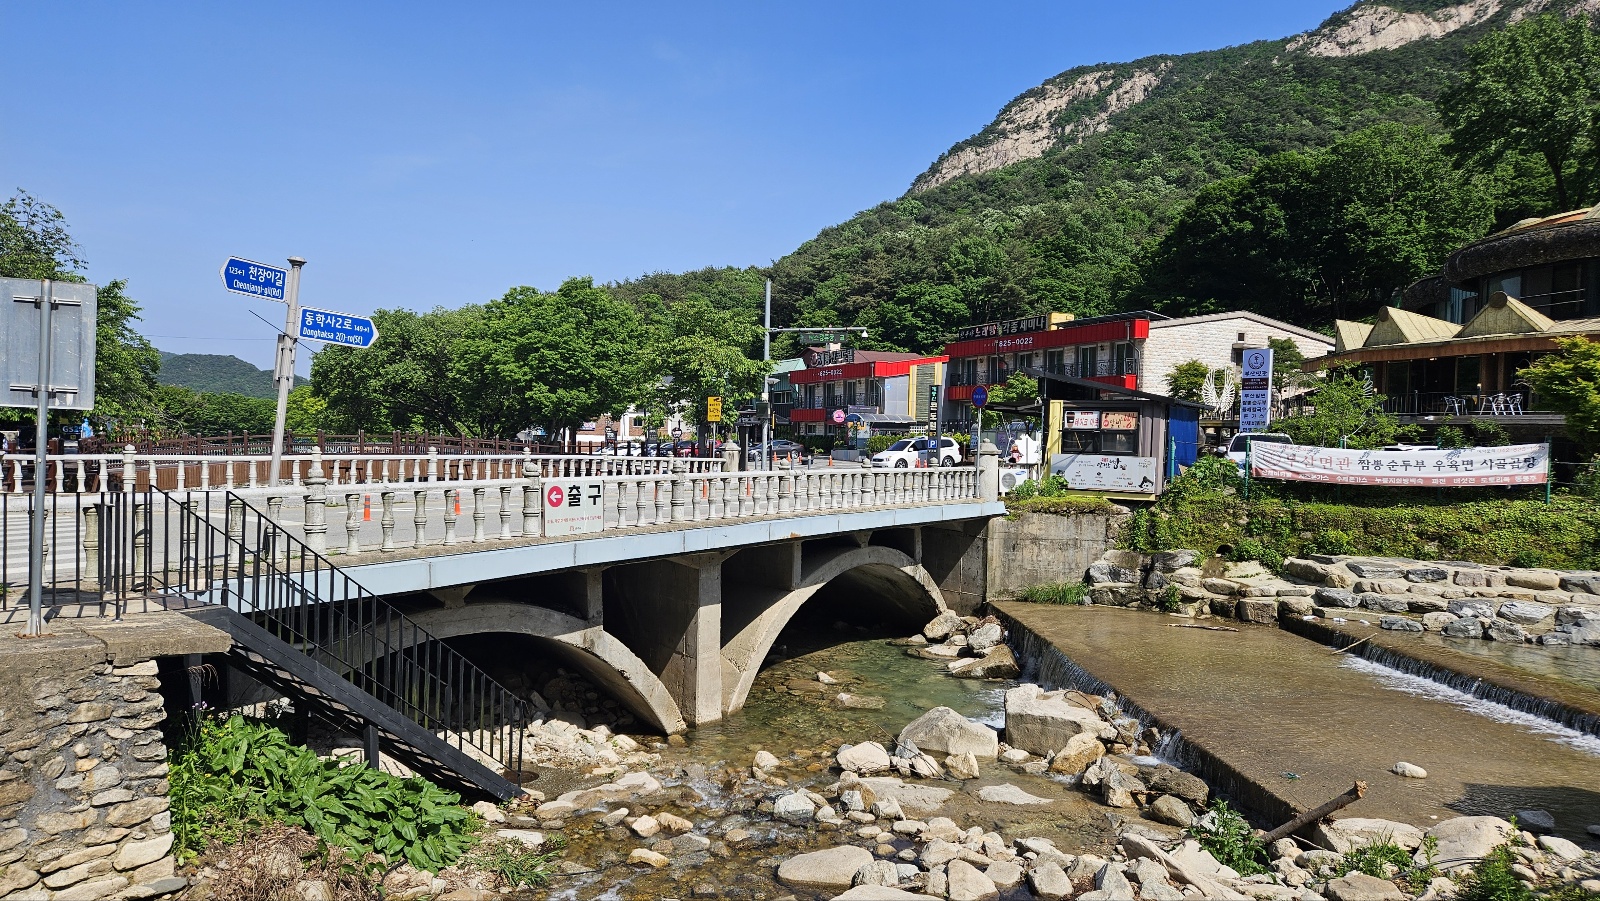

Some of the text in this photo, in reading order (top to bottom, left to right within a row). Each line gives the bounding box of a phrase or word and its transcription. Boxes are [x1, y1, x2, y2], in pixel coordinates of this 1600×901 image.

[248, 265, 284, 287] 천장이길
[304, 312, 353, 330] 동학사2로
[975, 324, 997, 338] 노래방
[1002, 320, 1019, 334] 각종
[1020, 316, 1045, 332] 세미나
[302, 327, 334, 340] Donghaksa
[998, 337, 1033, 347] 825-0022
[1285, 452, 1353, 471] 부산면관
[1432, 459, 1474, 472] 우육면
[1480, 457, 1537, 471] 사골곰탕
[1453, 476, 1476, 484] 버섯전
[568, 484, 602, 507] 출구
